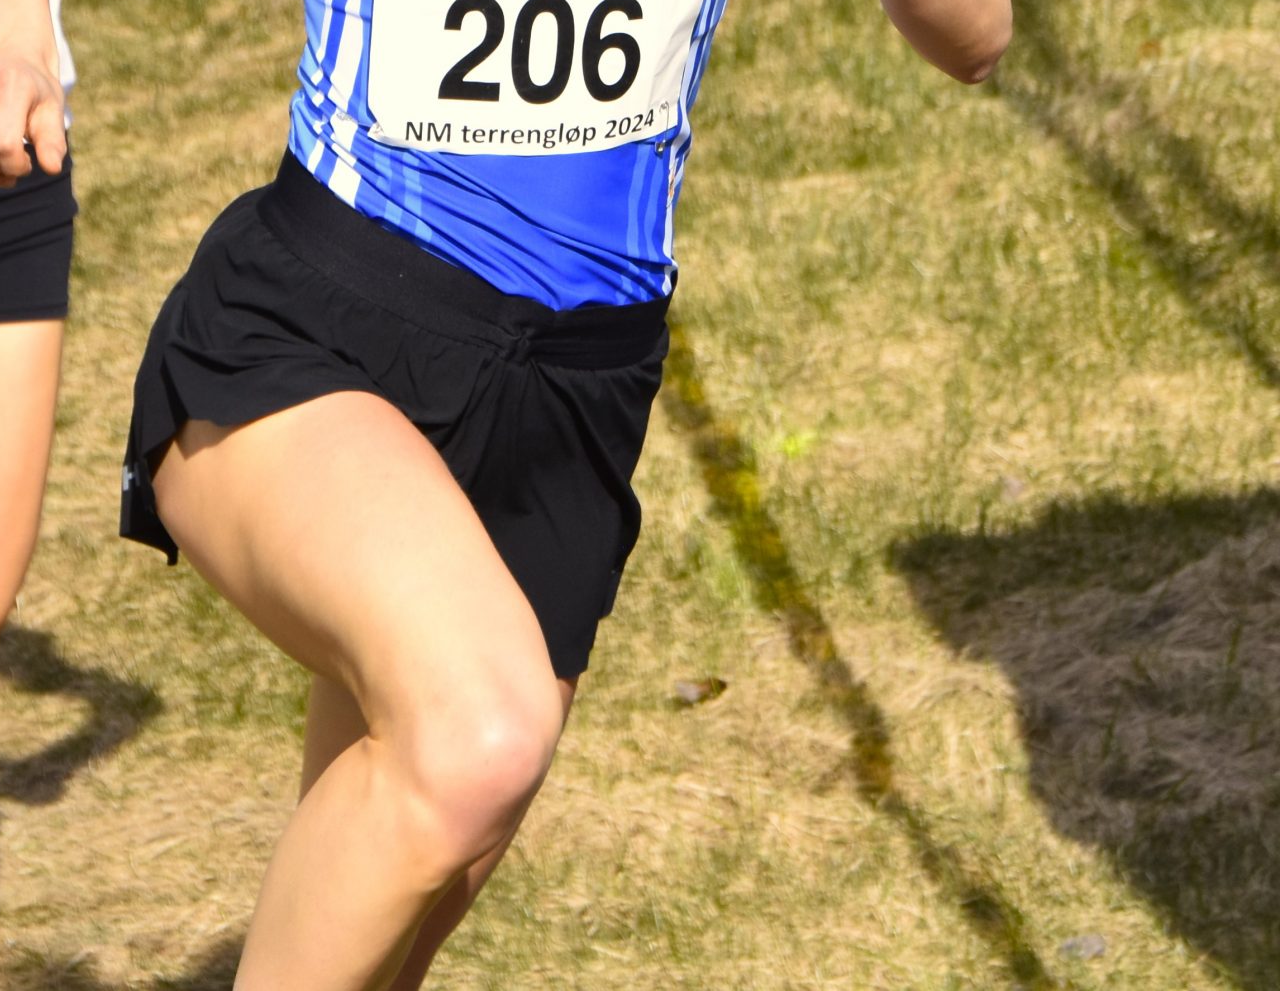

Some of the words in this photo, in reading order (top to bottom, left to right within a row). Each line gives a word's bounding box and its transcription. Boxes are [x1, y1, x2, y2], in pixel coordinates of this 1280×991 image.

[405, 121, 452, 143] NM
[462, 123, 597, 149] terrengløp
[604, 107, 655, 139] 2024
